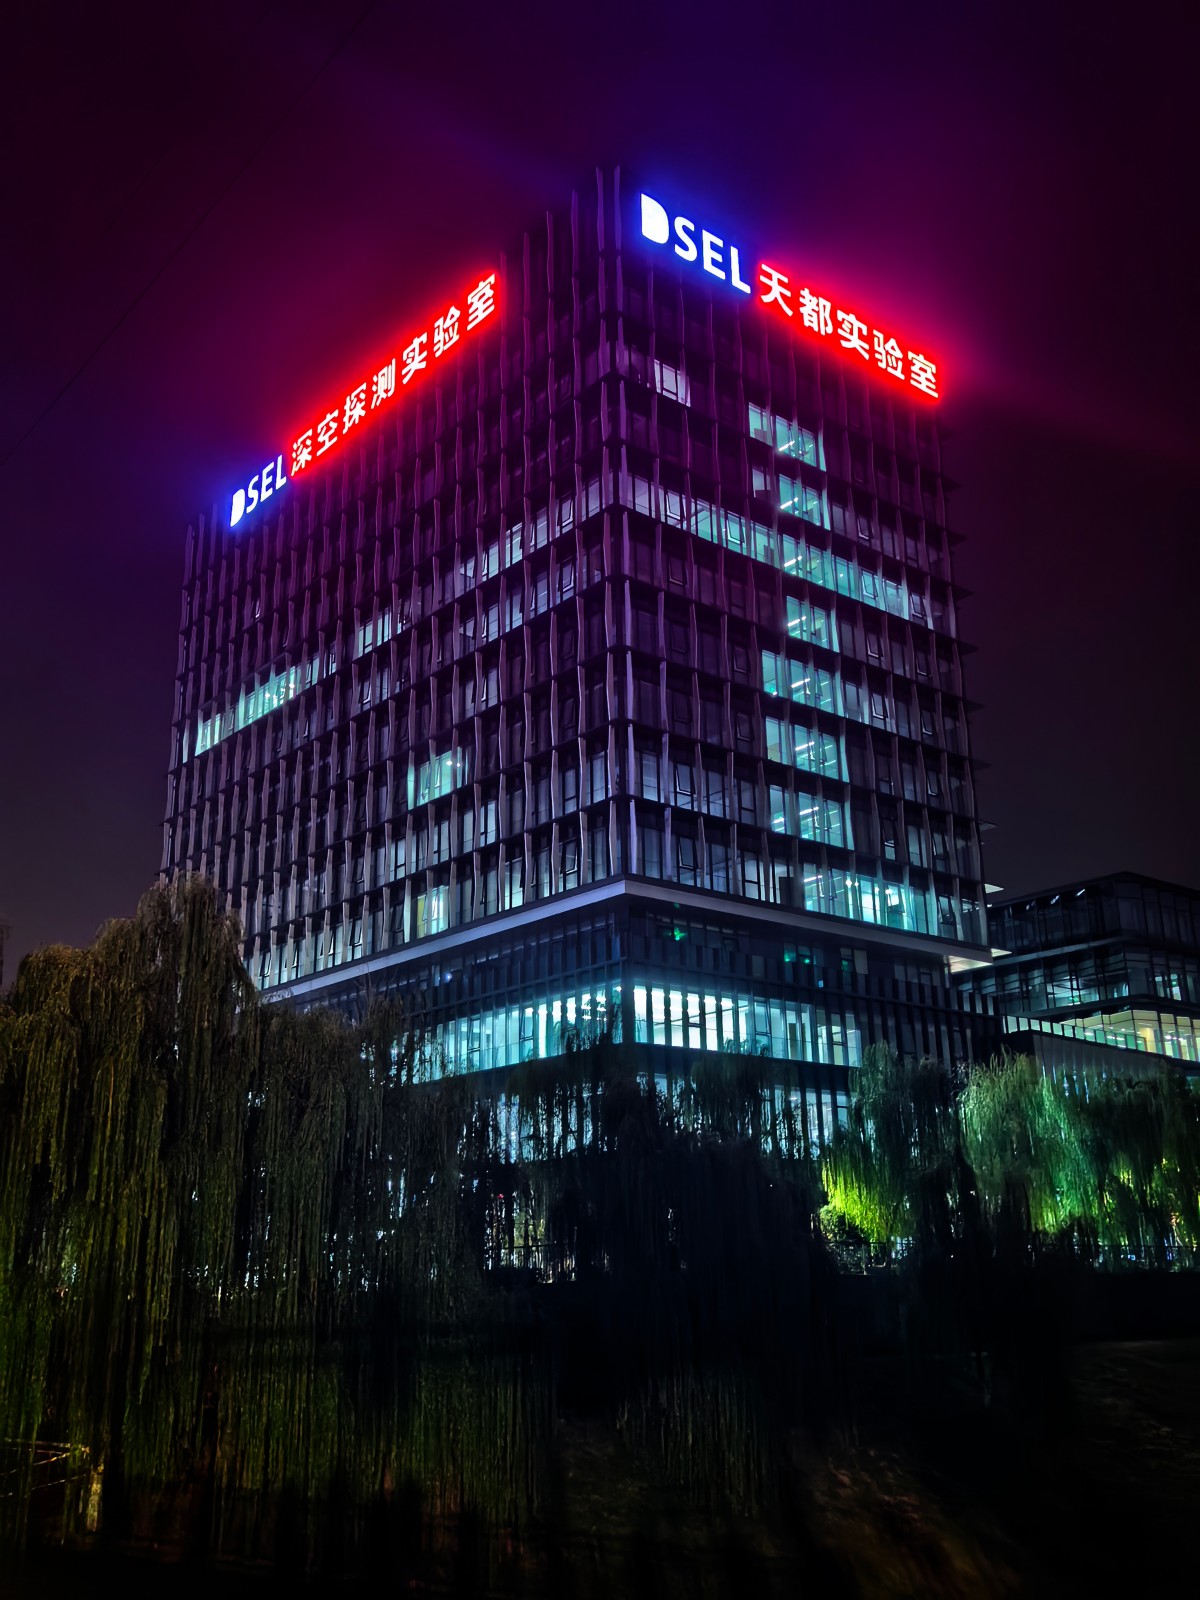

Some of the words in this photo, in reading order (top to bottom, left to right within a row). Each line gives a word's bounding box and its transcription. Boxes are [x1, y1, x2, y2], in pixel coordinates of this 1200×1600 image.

[290, 273, 496, 476] 深空探测实验室
[759, 263, 939, 398] 天都实验室
